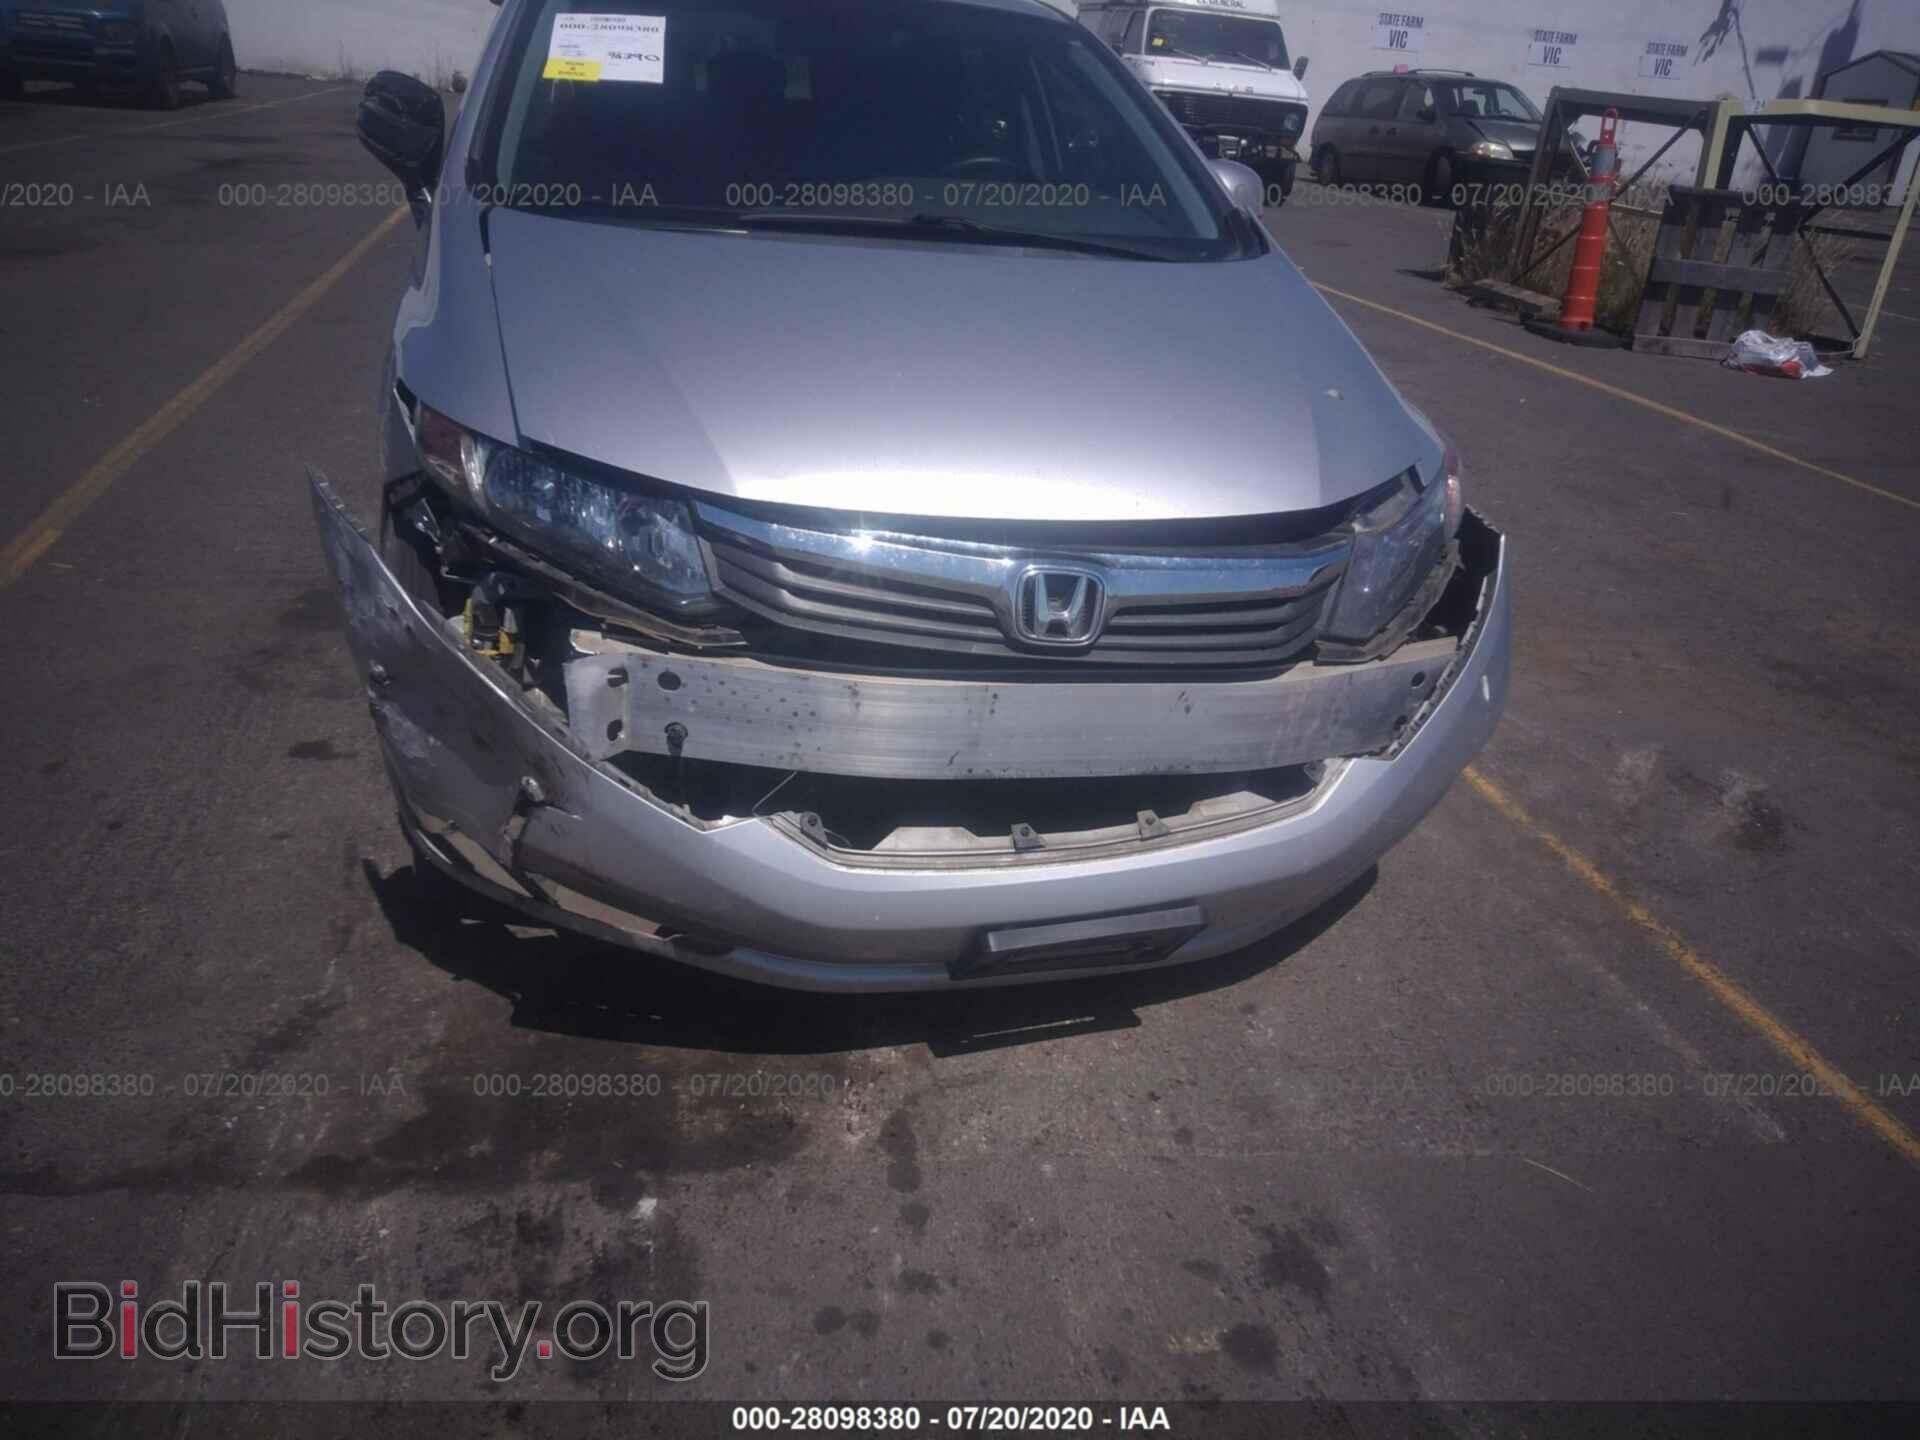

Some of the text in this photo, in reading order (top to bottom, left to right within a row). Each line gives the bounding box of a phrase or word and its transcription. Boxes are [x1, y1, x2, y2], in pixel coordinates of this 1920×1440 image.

[1379, 12, 1424, 28] STATE FARM
[1389, 29, 1408, 48] VIC
[1534, 29, 1577, 45] STATE FARM
[1543, 46, 1561, 65] VIC
[1654, 58, 1672, 77] VIC
